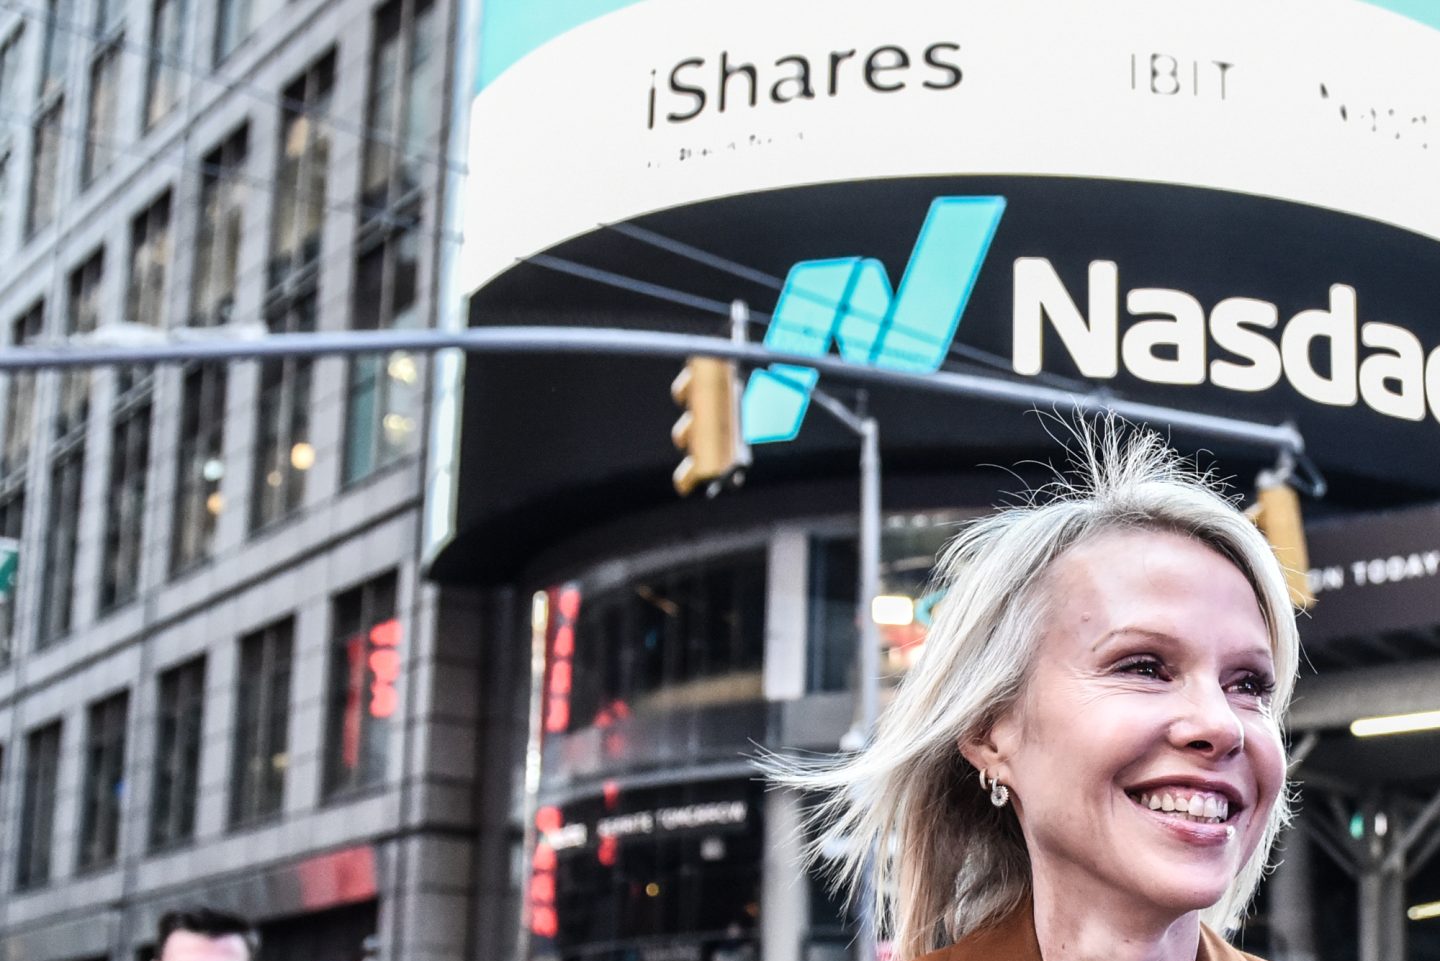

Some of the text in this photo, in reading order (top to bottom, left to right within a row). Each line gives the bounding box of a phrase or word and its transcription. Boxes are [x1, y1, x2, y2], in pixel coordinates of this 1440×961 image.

[646, 42, 964, 130] iShares
[1130, 53, 1235, 100] IBIT
[1351, 550, 1440, 586] TODAY
